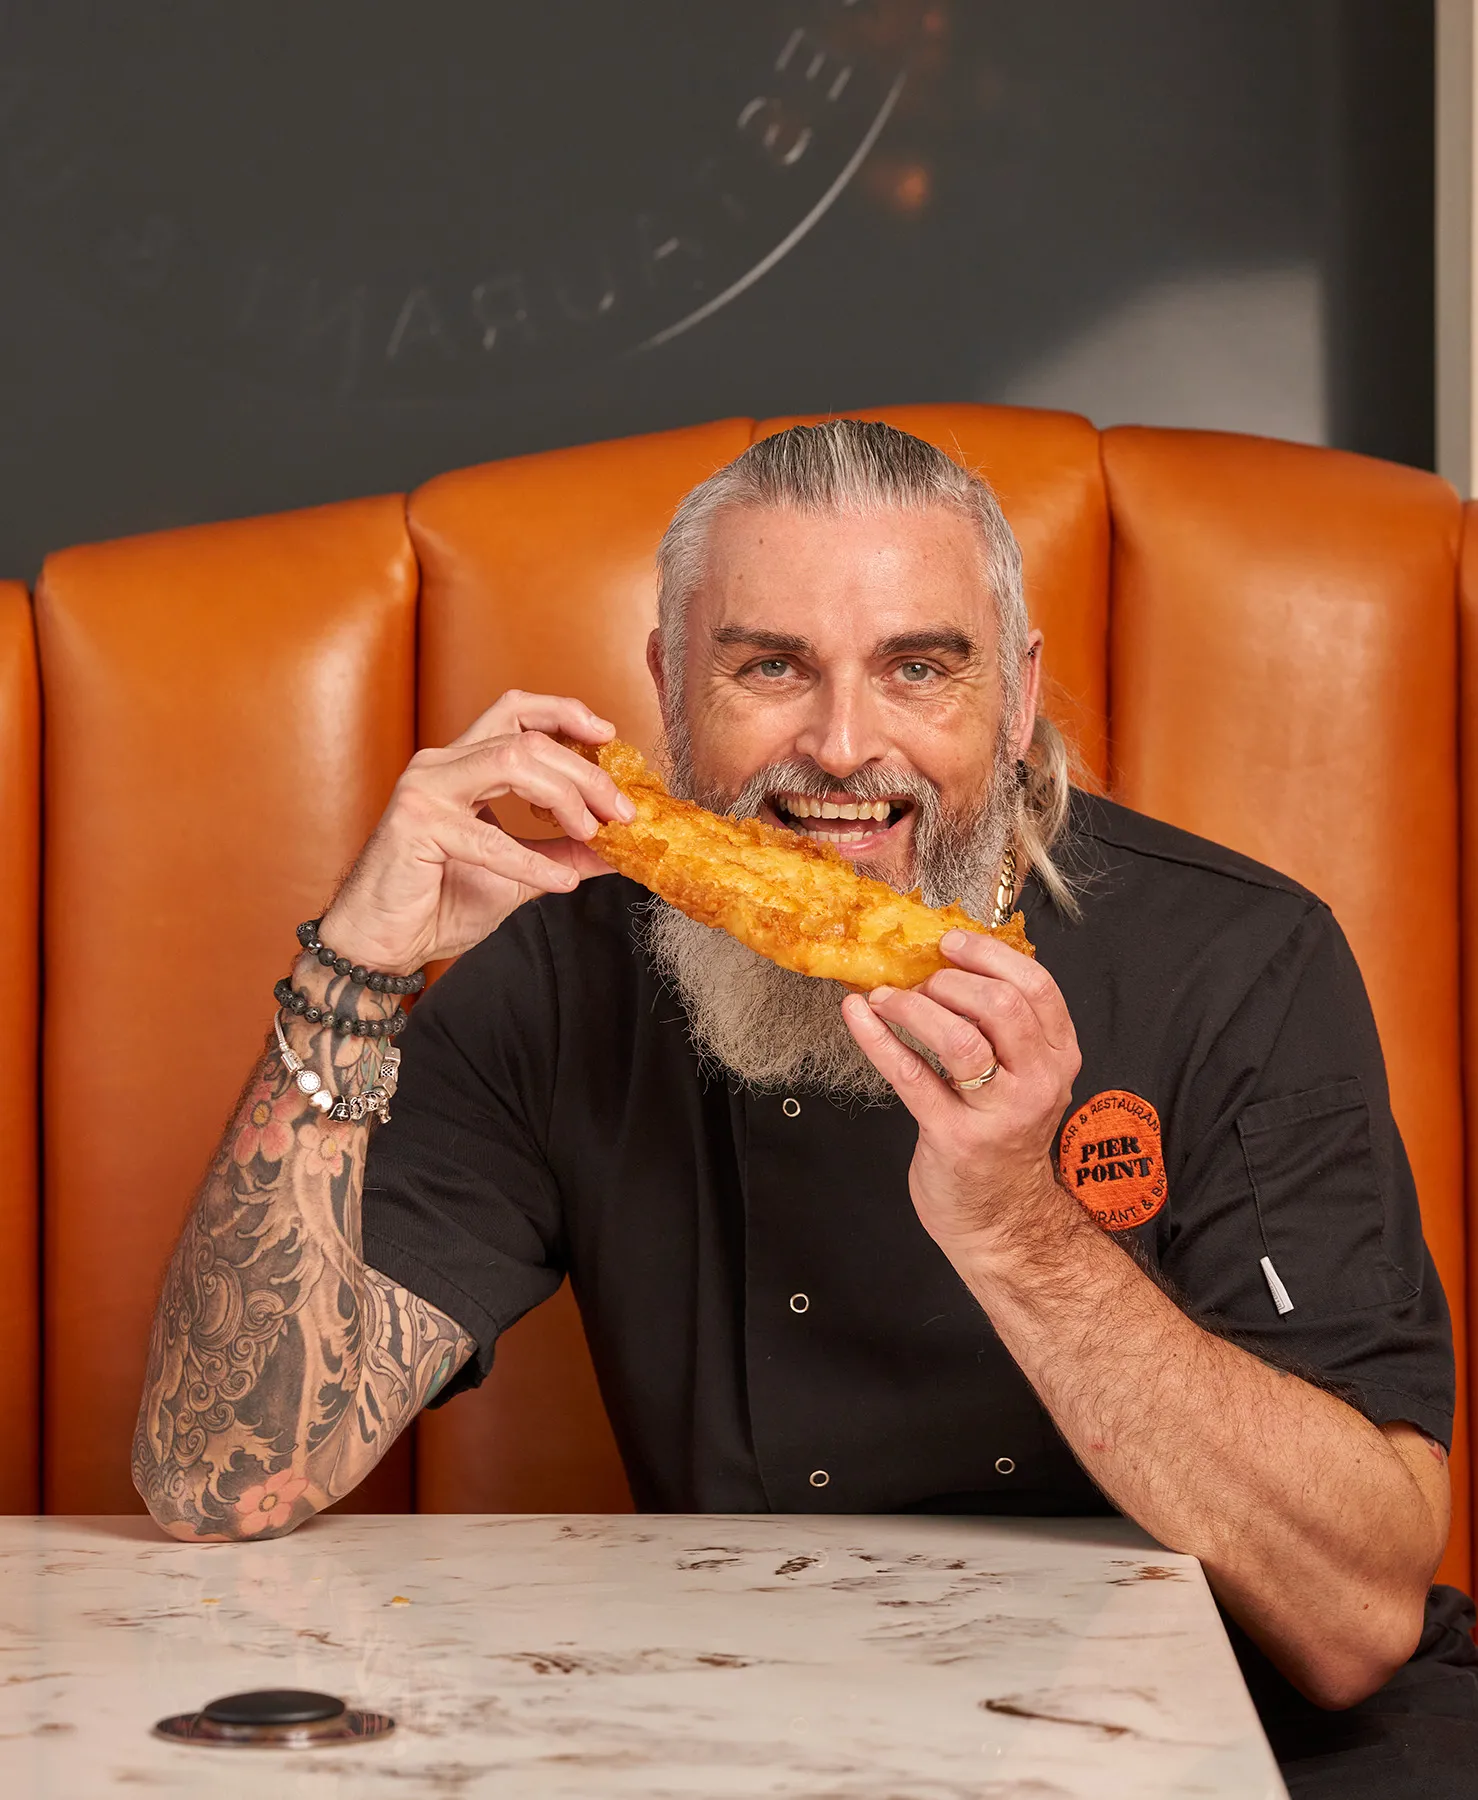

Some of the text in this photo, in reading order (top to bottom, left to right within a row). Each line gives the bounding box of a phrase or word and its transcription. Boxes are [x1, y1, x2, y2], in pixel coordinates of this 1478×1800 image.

[1062, 1125, 1078, 1154] BAR
[1079, 1114, 1088, 1125] &
[1081, 1136, 1141, 1164] PIER
[1075, 1157, 1154, 1187] POINT
[1142, 1199, 1154, 1210] &
